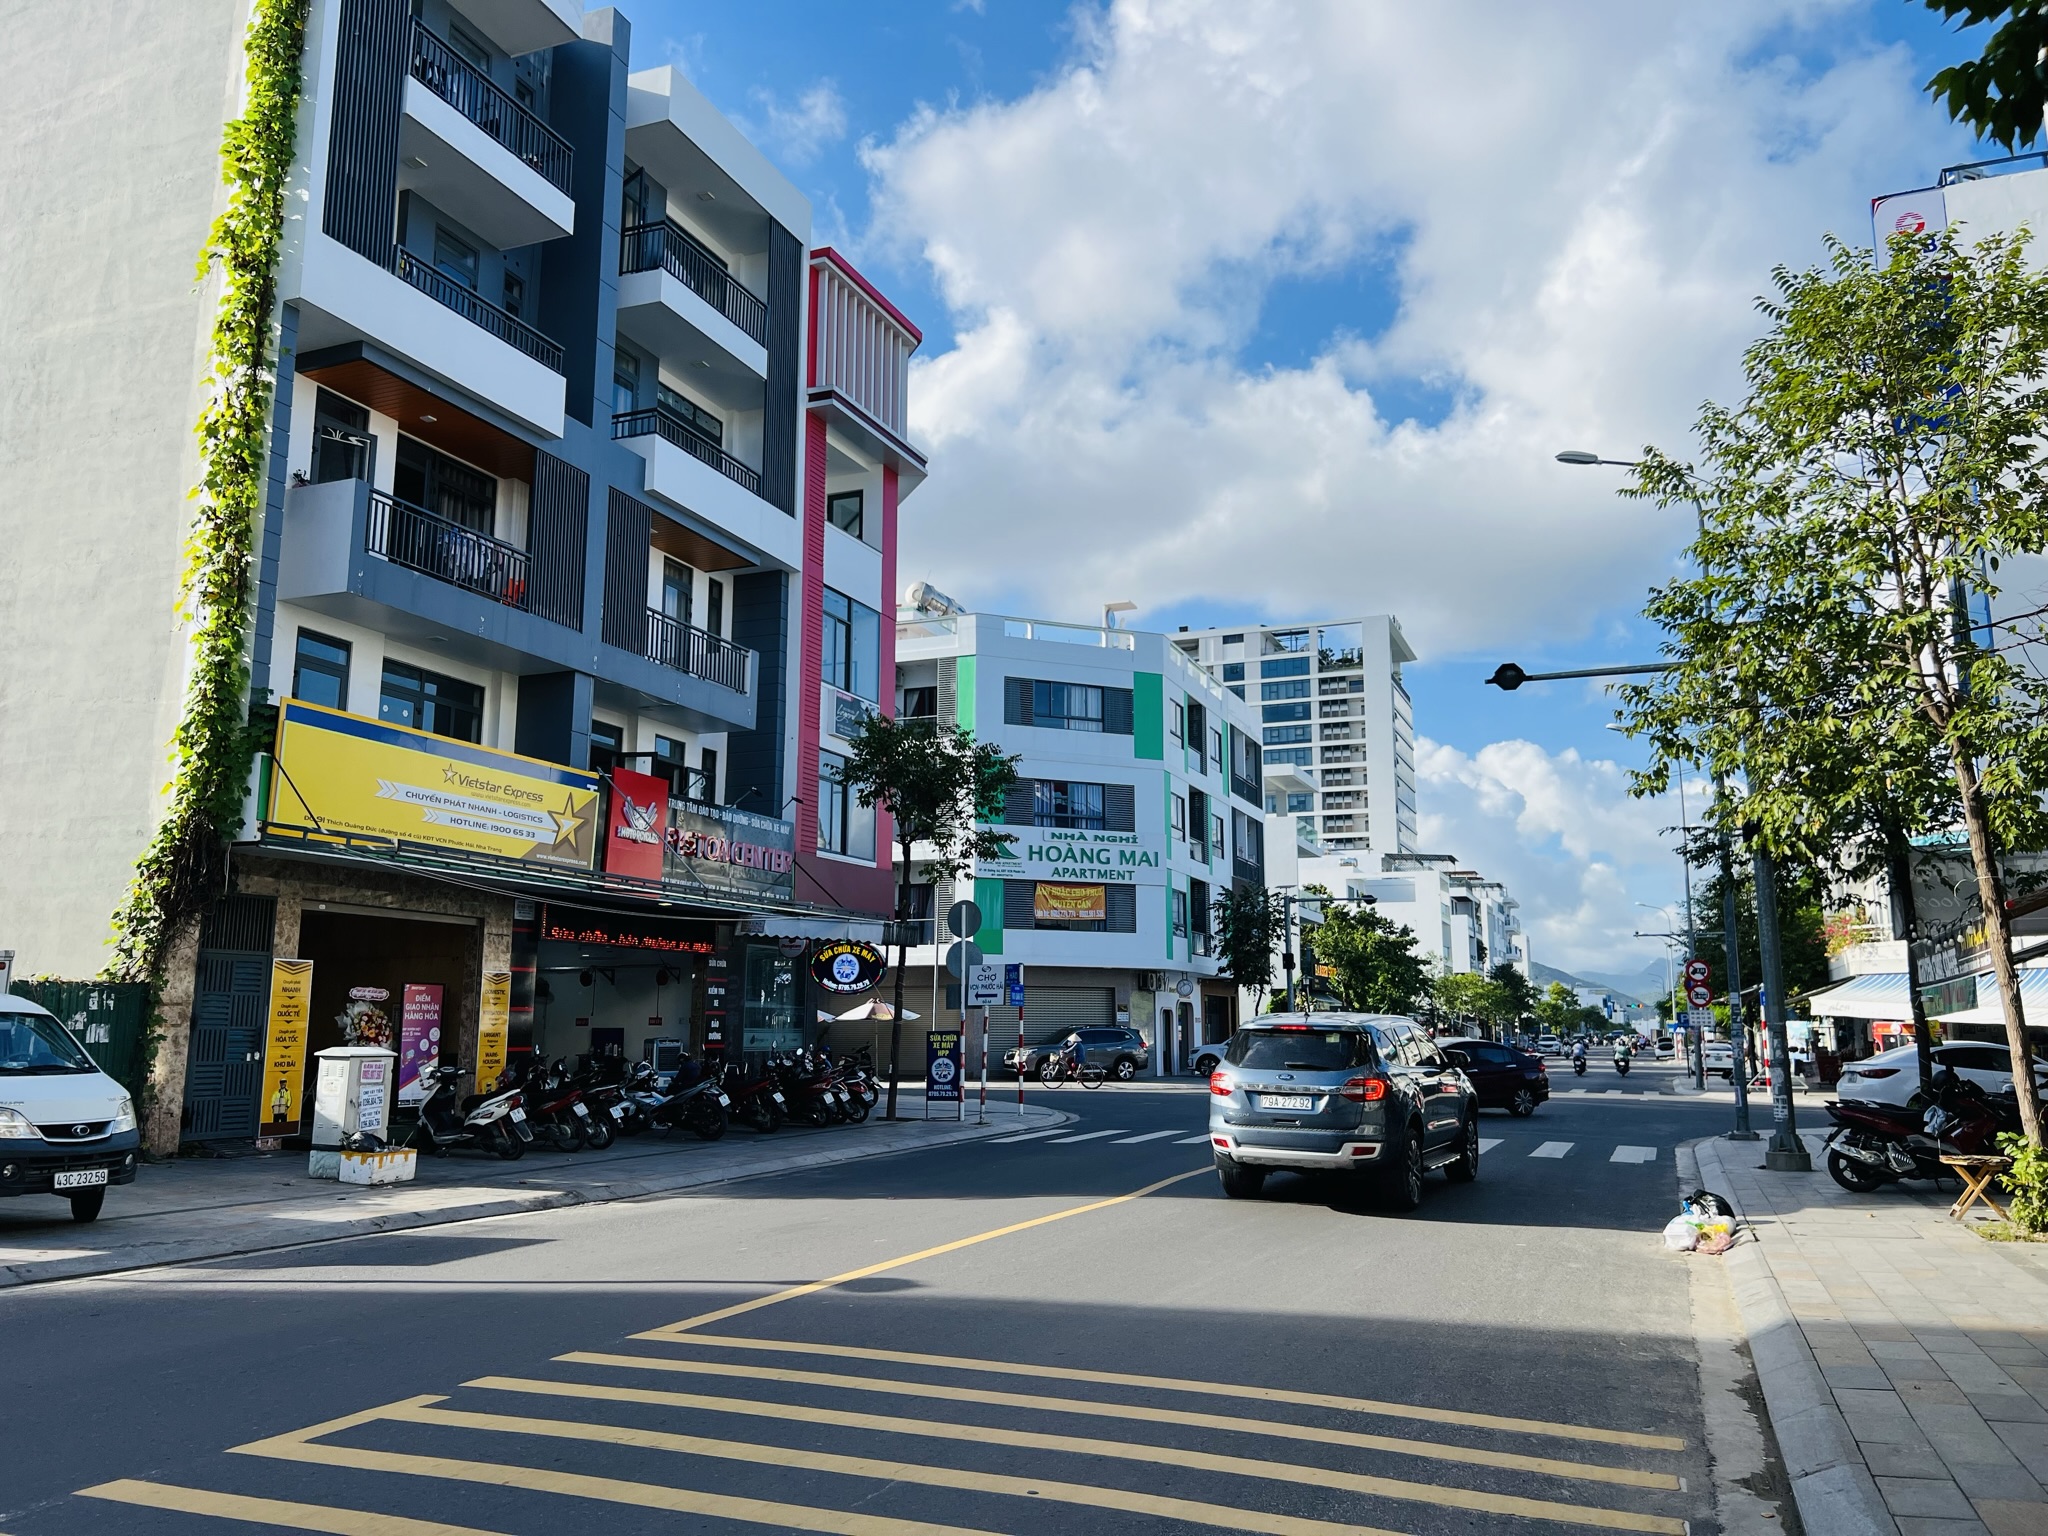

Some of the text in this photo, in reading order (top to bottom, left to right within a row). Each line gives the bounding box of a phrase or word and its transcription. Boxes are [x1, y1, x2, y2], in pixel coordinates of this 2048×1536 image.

[458, 774, 545, 803] Vietstar Express
[443, 797, 467, 809] PHÁT
[468, 802, 497, 815] NHANH
[503, 810, 543, 824] LOGISTICS
[668, 798, 686, 811] TRUNG
[686, 801, 698, 814] TÂM
[698, 804, 709, 816] ĐÀO
[709, 807, 719, 820] TẠO
[773, 823, 780, 833] XE
[490, 824, 512, 834] 1900
[513, 829, 524, 837] 65
[525, 831, 536, 839] 33
[1050, 831, 1139, 844] NHÀ NGHỈ
[487, 845, 503, 854] Trang
[664, 827, 793, 873] PISTON CENTER
[1028, 842, 1159, 868] HOÀNG MAI
[1051, 866, 1136, 881] APARTMENT
[820, 944, 876, 963] SỬA CHỮA XE MÁY
[977, 973, 997, 982] CHỢ
[415, 993, 431, 1002] ĐIỂM
[405, 1003, 421, 1011] GIAO
[404, 1011, 438, 1020] HÀNG HÓA
[287, 1034, 299, 1042] TỐC
[930, 1033, 958, 1041] SỬA CHỮA
[941, 1041, 954, 1049] MÁY
